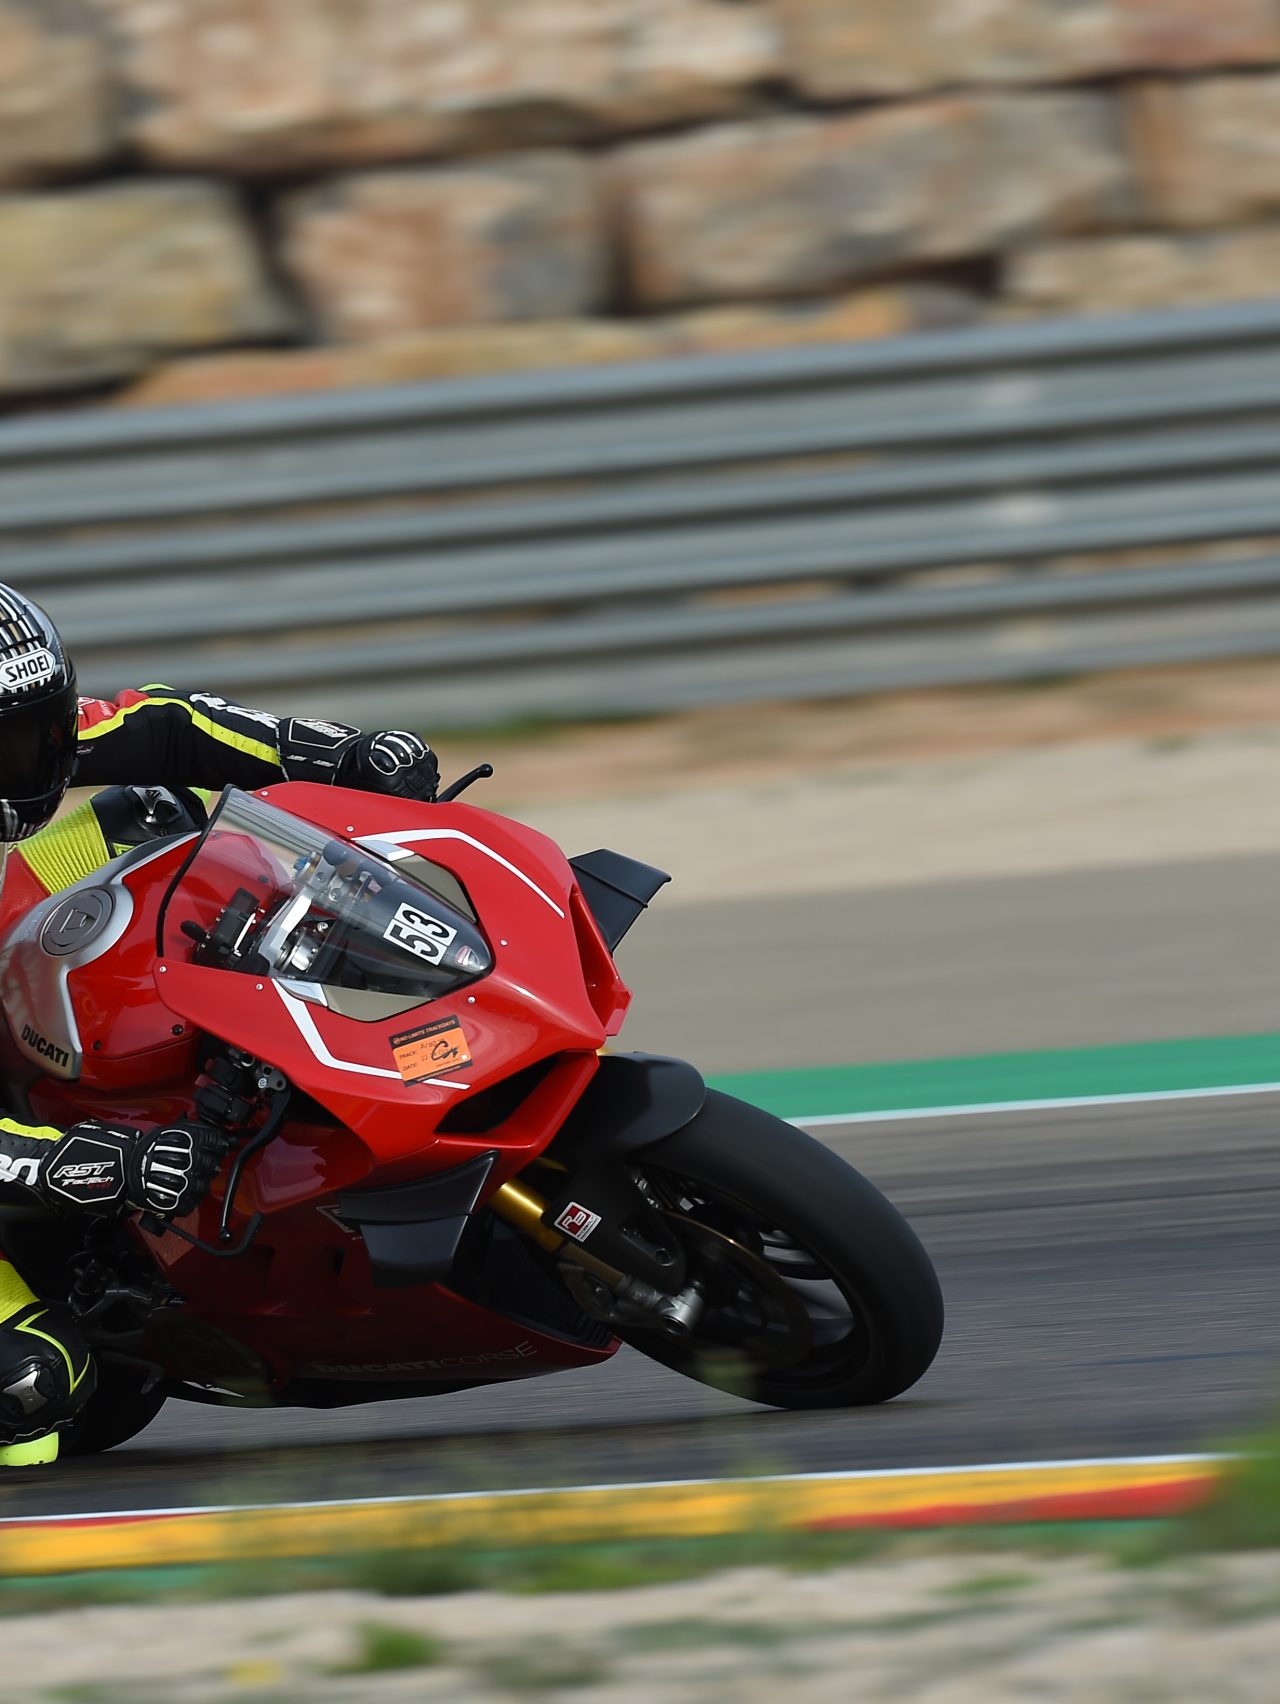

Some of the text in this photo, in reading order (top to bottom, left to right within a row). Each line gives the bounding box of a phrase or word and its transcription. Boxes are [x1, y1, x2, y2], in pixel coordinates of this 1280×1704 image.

[4, 654, 50, 683] SHOEI
[389, 909, 450, 958] 53
[21, 1023, 70, 1068] DUCATI
[53, 1161, 116, 1179] RST
